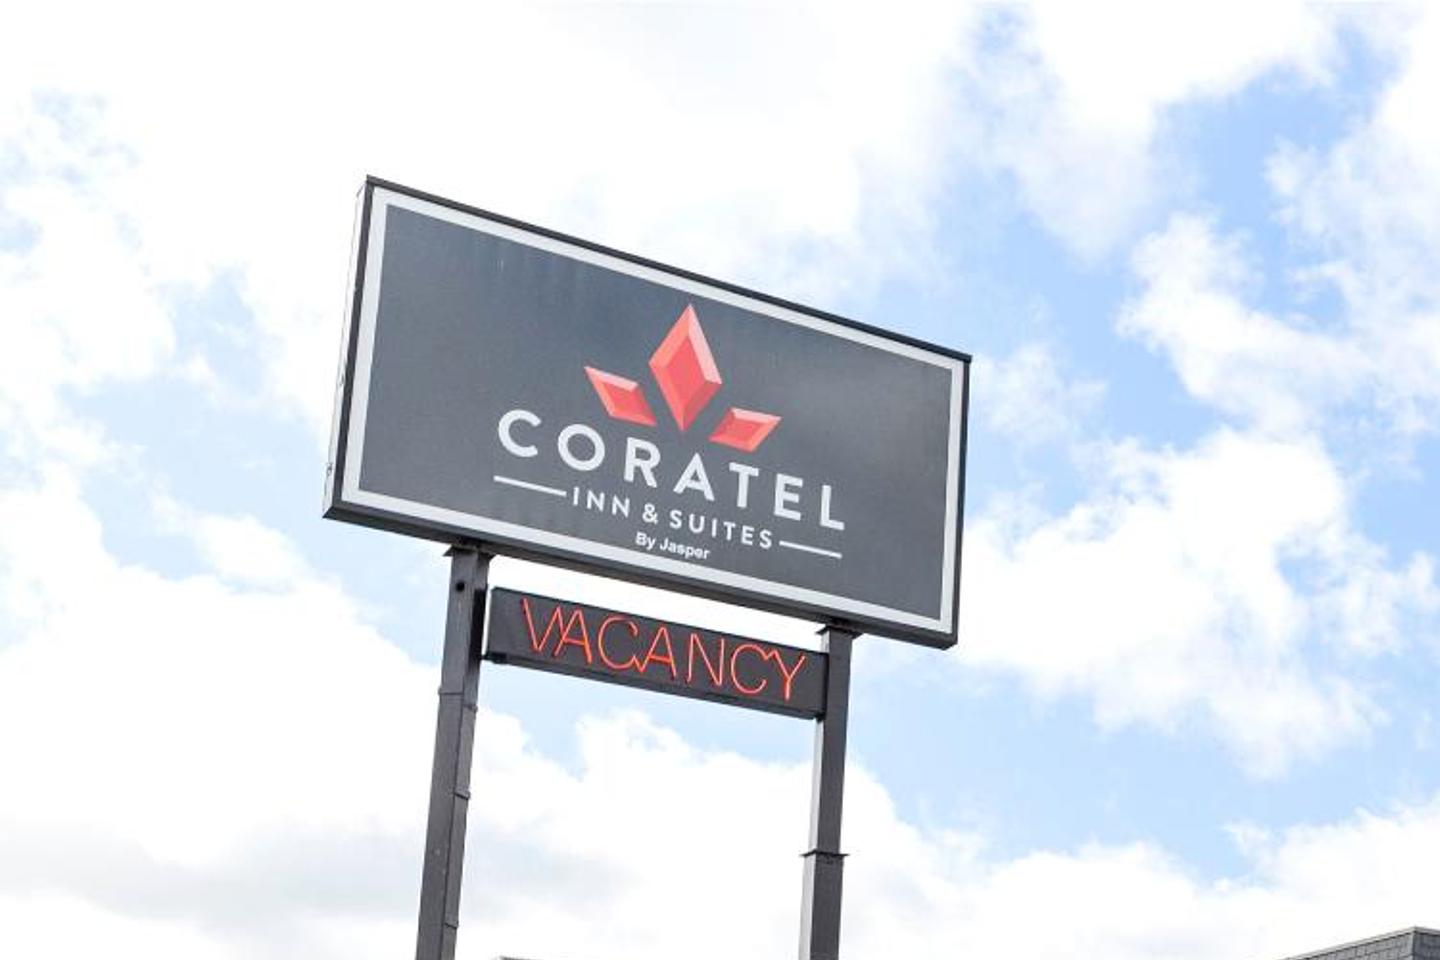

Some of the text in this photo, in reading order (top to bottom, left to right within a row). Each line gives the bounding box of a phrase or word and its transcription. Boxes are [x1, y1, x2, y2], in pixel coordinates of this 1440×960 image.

[497, 409, 845, 531] CORATEL
[572, 486, 774, 549] INN & SUITES
[635, 532, 711, 562] By Jasper
[521, 597, 807, 700] VACANCY
